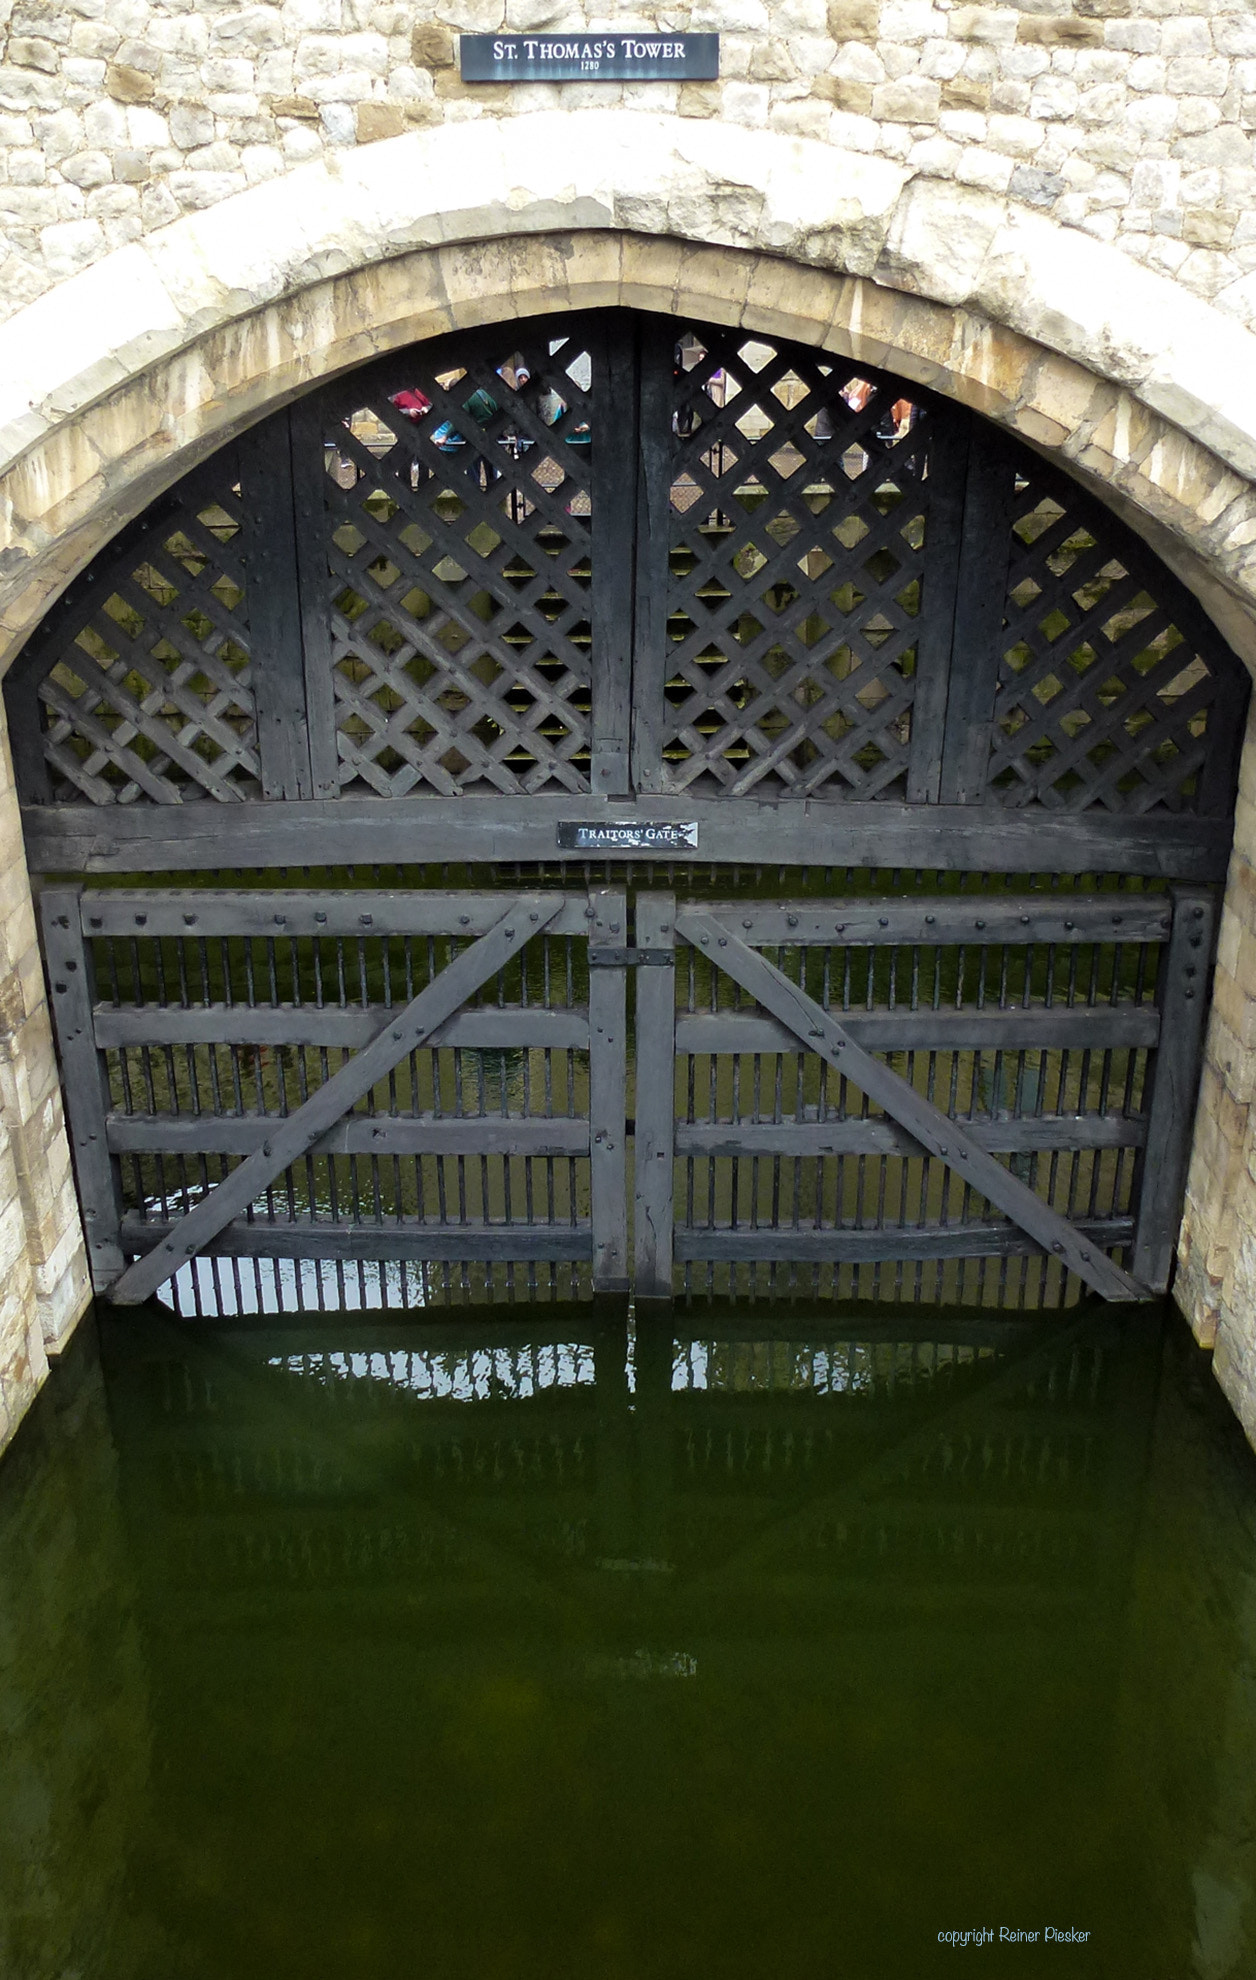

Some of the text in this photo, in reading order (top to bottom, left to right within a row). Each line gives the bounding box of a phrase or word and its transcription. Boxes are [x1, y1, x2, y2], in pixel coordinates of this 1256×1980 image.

[493, 39, 686, 60] ST. THOMAS'S TOWER
[580, 60, 600, 71] 1280
[578, 828, 678, 840] TRAITORS' GATE
